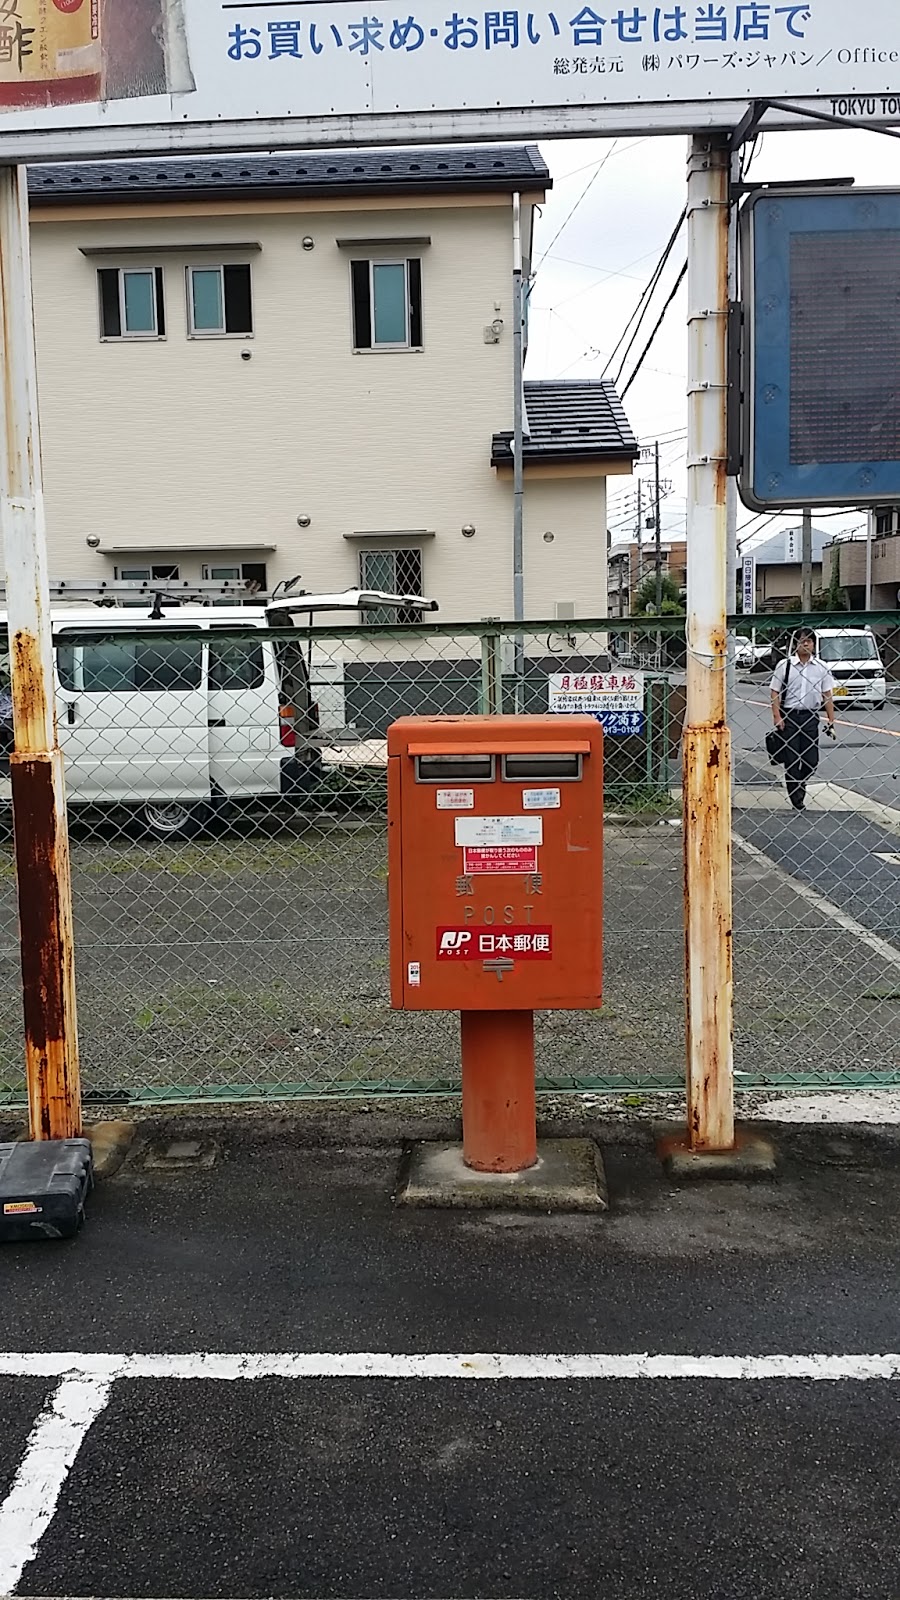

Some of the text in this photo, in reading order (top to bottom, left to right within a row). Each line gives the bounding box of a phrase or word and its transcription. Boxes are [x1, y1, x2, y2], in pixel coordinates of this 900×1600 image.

[227, 2, 812, 60] お買い求め・お問い合せは当店で
[553, 55, 625, 75] 総発売元
[830, 99, 876, 116] TOKYU
[560, 674, 636, 691] 月極駐車場
[592, 712, 641, 726] ング商事
[464, 905, 534, 925] POST
[479, 934, 551, 952] 日本郵便
